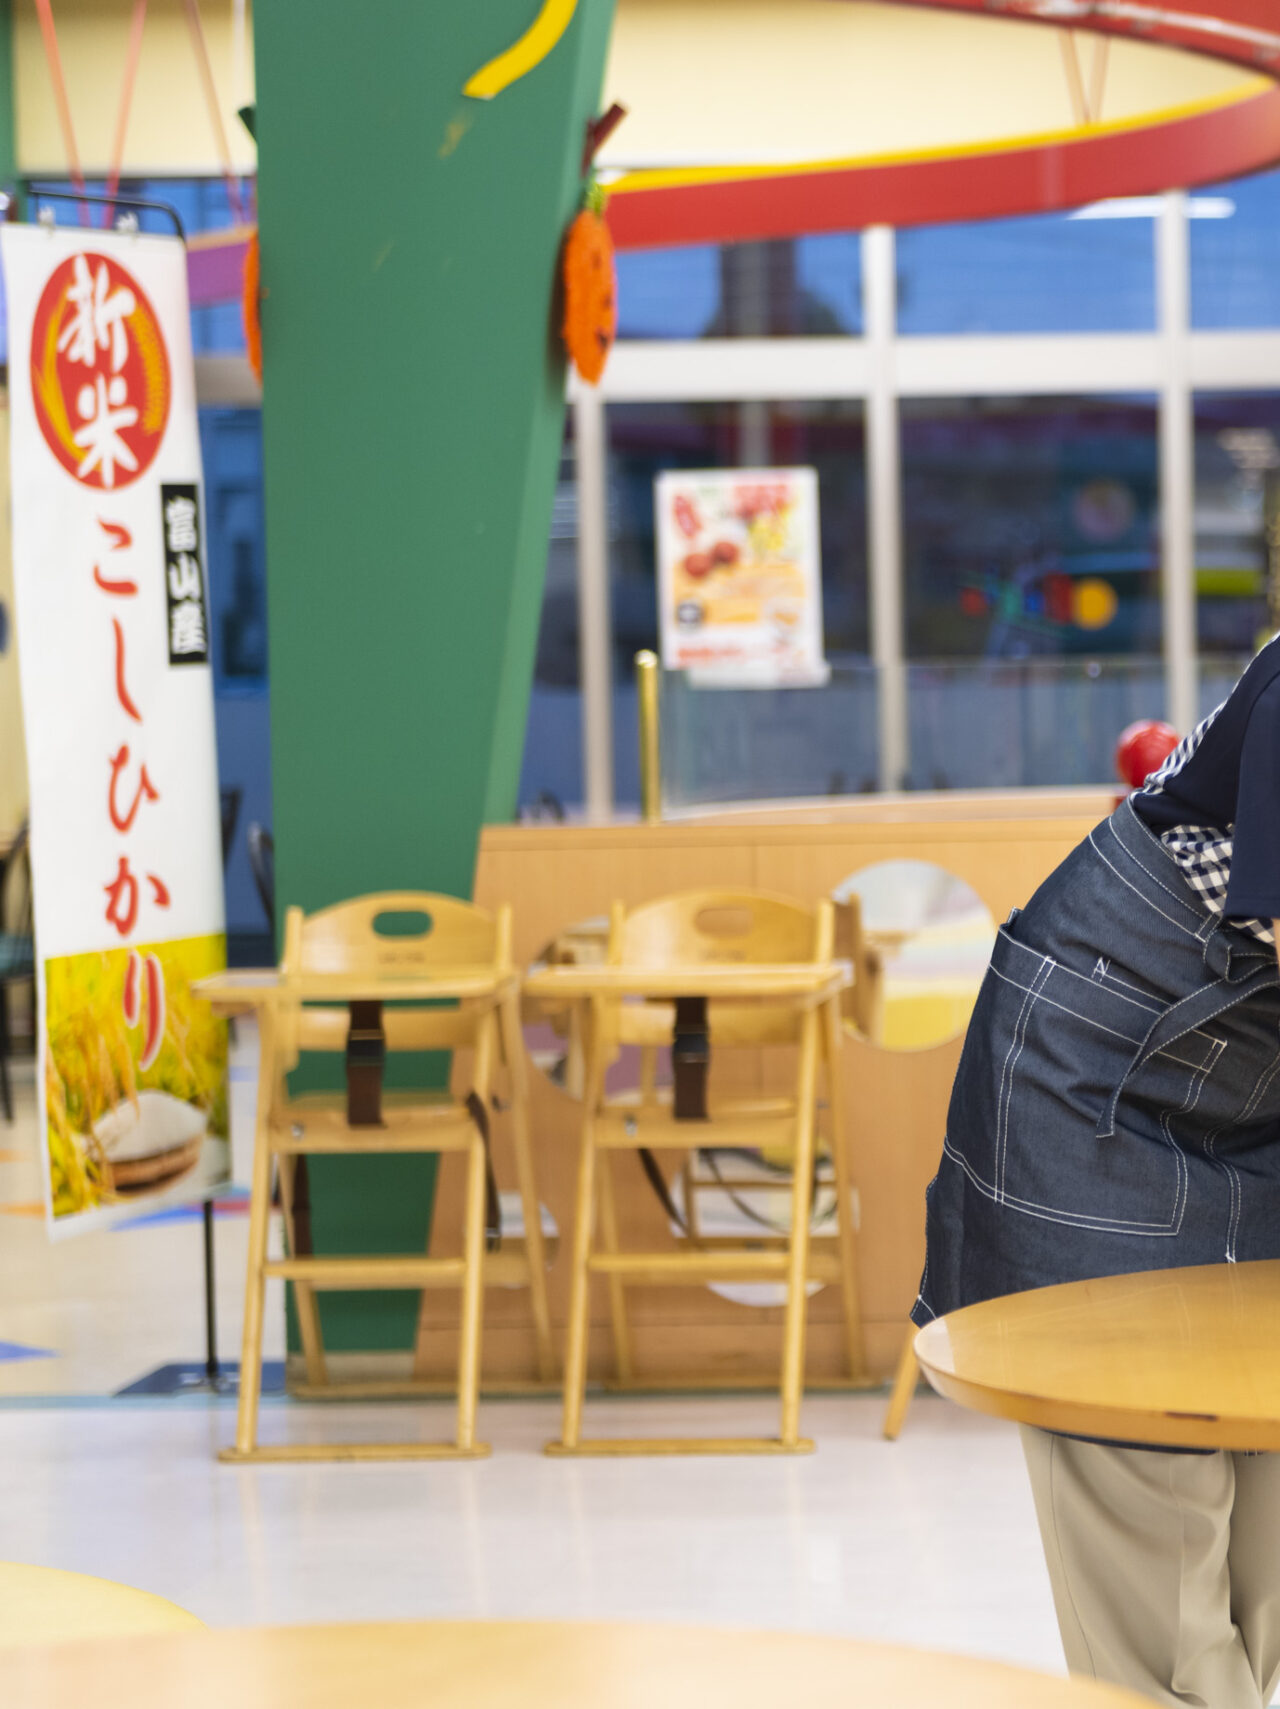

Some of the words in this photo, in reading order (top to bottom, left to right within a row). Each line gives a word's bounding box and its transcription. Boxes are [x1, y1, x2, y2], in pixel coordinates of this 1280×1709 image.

[58, 253, 138, 487] 新米
[92, 517, 170, 1069] こしひかり
